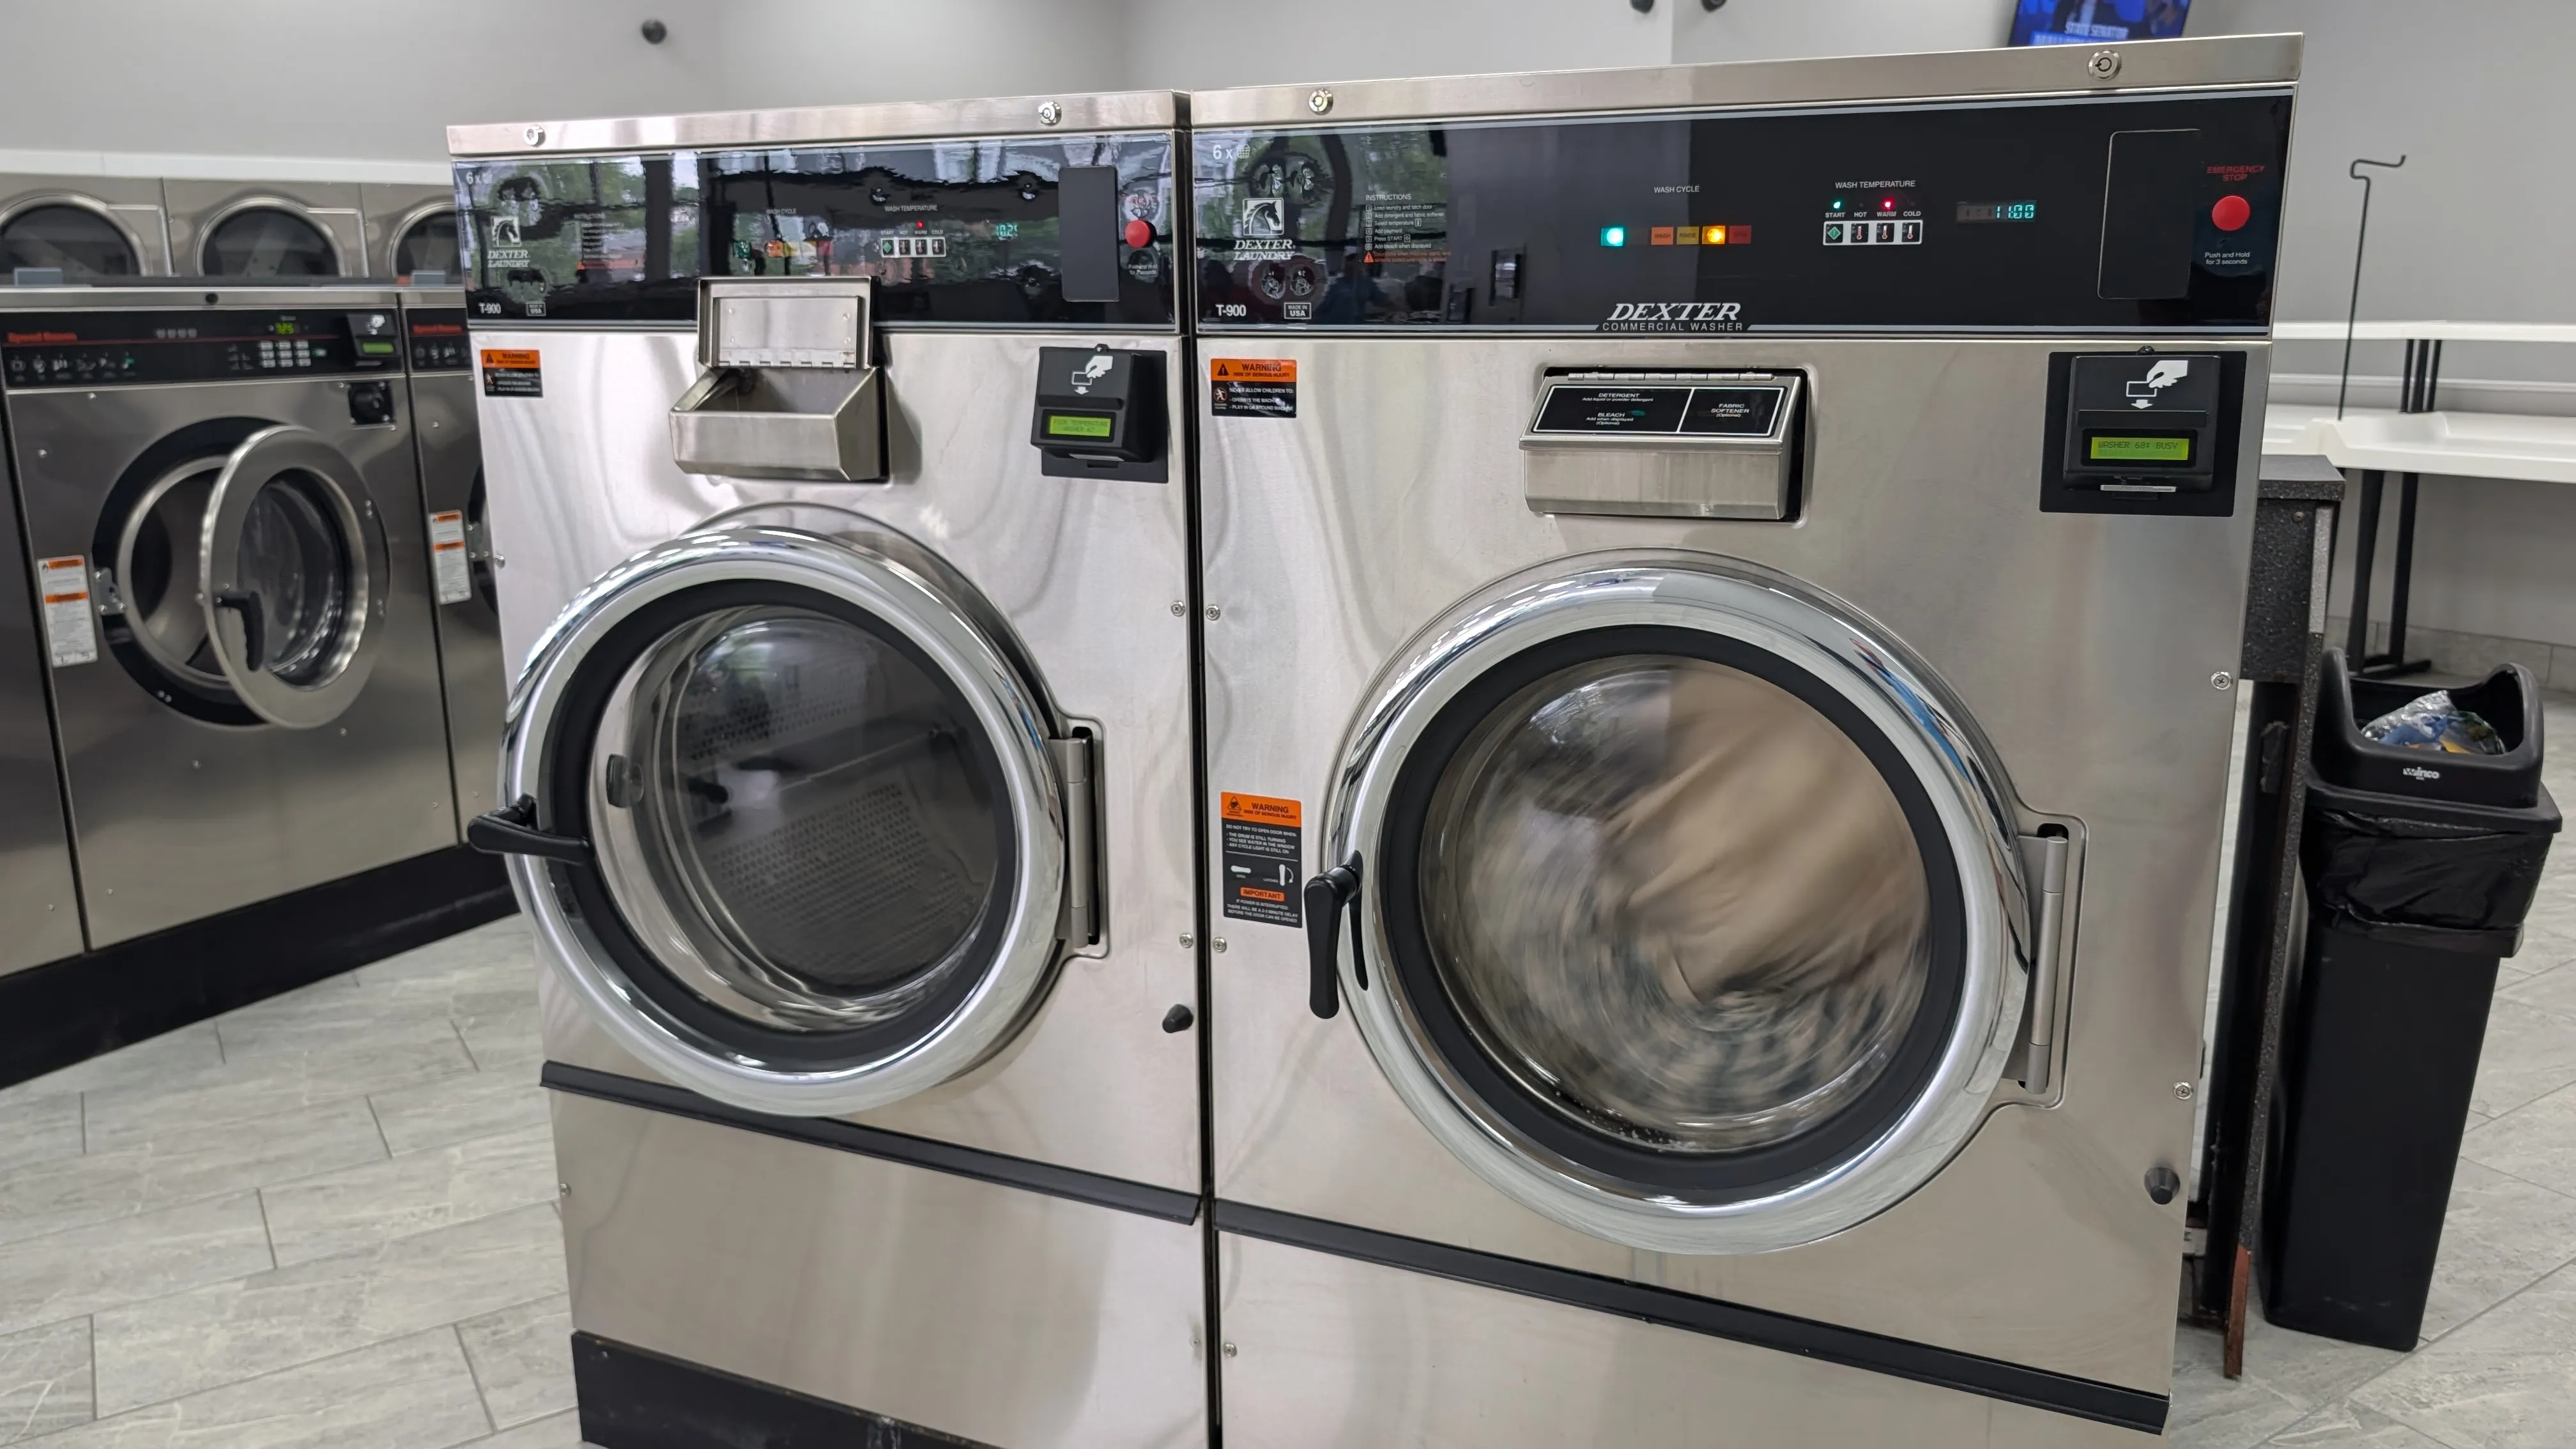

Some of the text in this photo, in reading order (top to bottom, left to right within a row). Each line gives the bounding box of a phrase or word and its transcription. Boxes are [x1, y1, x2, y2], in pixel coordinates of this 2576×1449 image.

[1213, 144, 1222, 160] 6
[2207, 165, 2266, 174] EMERGENCY
[466, 172, 473, 185] 6
[1234, 239, 1294, 250] DEXTER
[487, 249, 529, 259] DEXTER
[1234, 251, 1295, 261] LAUNDRY
[479, 303, 502, 314] T-900
[1215, 303, 1246, 317] T-900
[1606, 302, 1741, 321] DEXTER
[1602, 323, 1743, 332] COMMERCIAL WASHER
[1241, 363, 1282, 372] WARNING
[1251, 802, 1289, 813] WARNING
[1243, 889, 1282, 900] IMPORTANT
